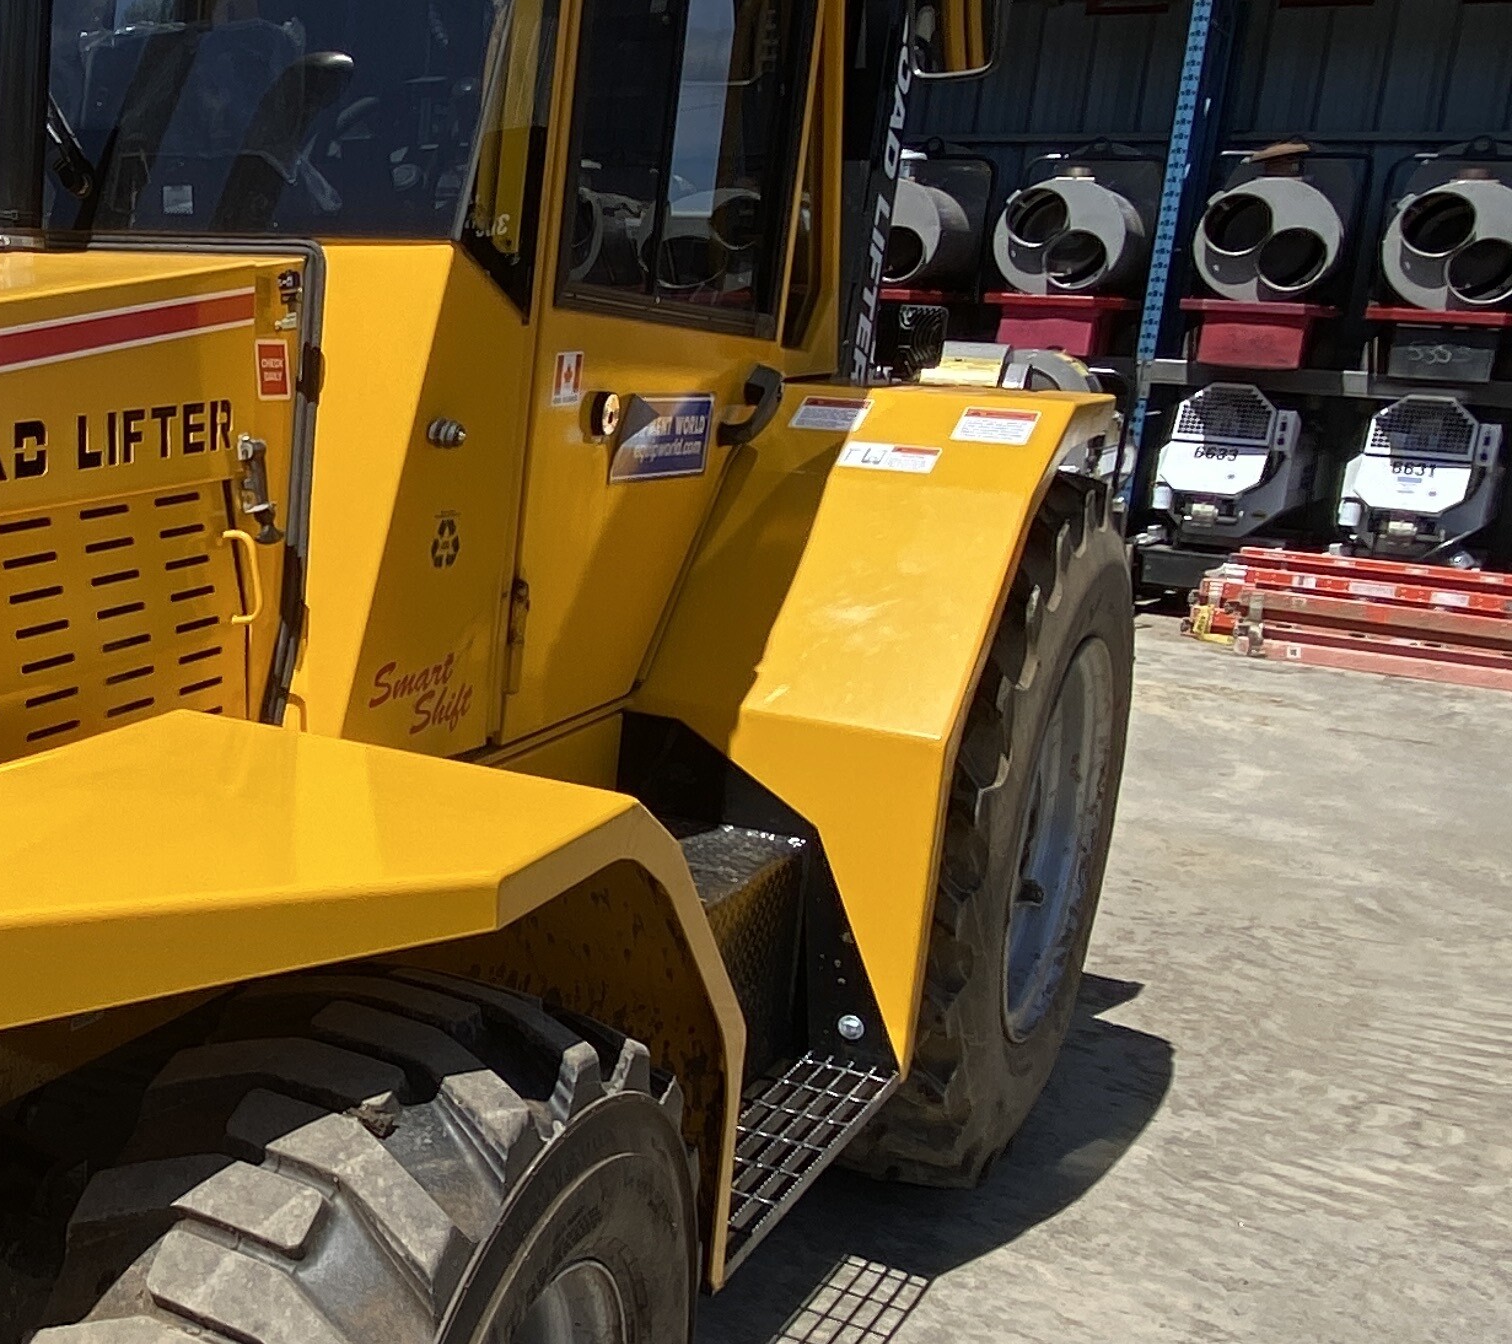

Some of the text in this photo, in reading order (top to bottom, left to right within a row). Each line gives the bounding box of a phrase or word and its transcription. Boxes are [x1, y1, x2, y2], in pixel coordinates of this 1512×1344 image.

[76, 398, 234, 470] LIFTER
[368, 652, 455, 709] Smart
[409, 682, 474, 735] Shift
